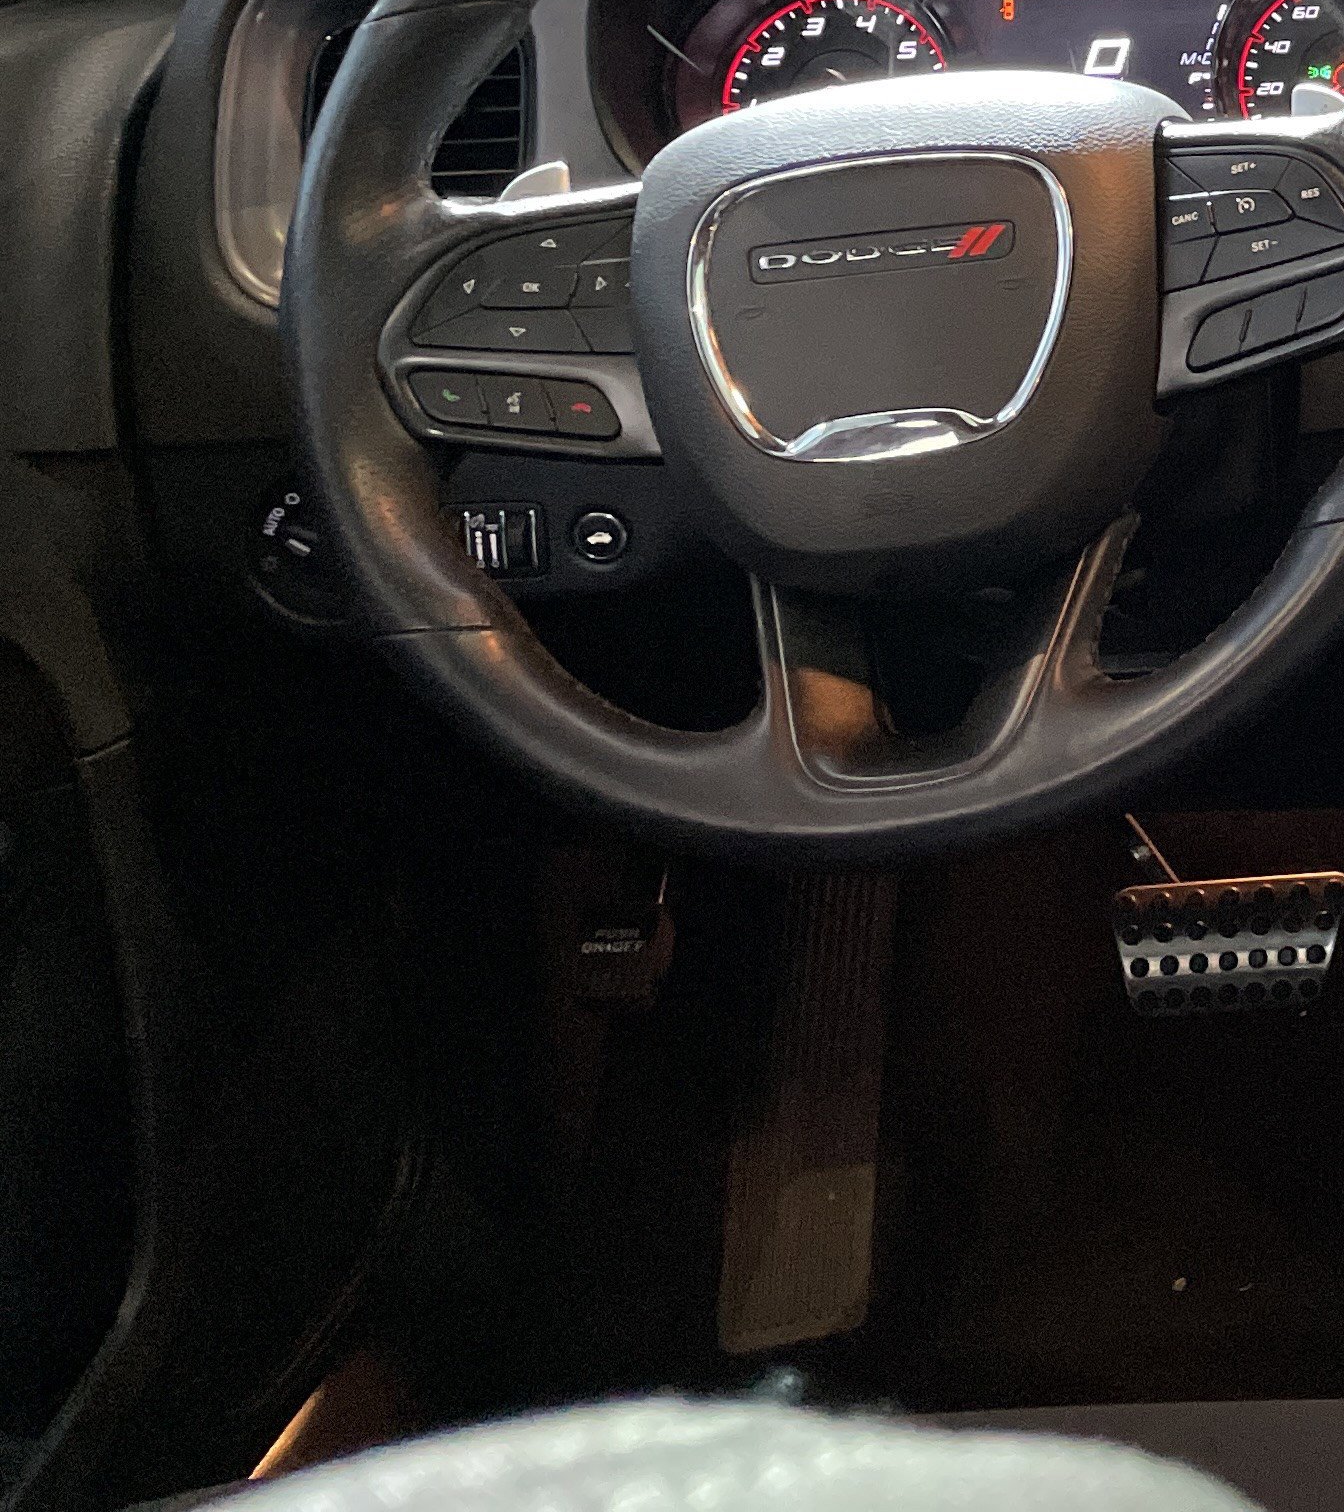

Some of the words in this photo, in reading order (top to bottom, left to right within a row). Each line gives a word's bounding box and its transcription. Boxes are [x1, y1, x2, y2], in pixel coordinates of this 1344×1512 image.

[1292, 6, 1320, 19] 60
[801, 16, 826, 37] 3
[855, 14, 877, 34] 4
[761, 46, 786, 66] 2
[896, 40, 918, 59] 5
[1264, 40, 1291, 54] 40
[1256, 82, 1284, 96] 20
[1171, 211, 1199, 226] CANC
[758, 235, 962, 271] DODGE
